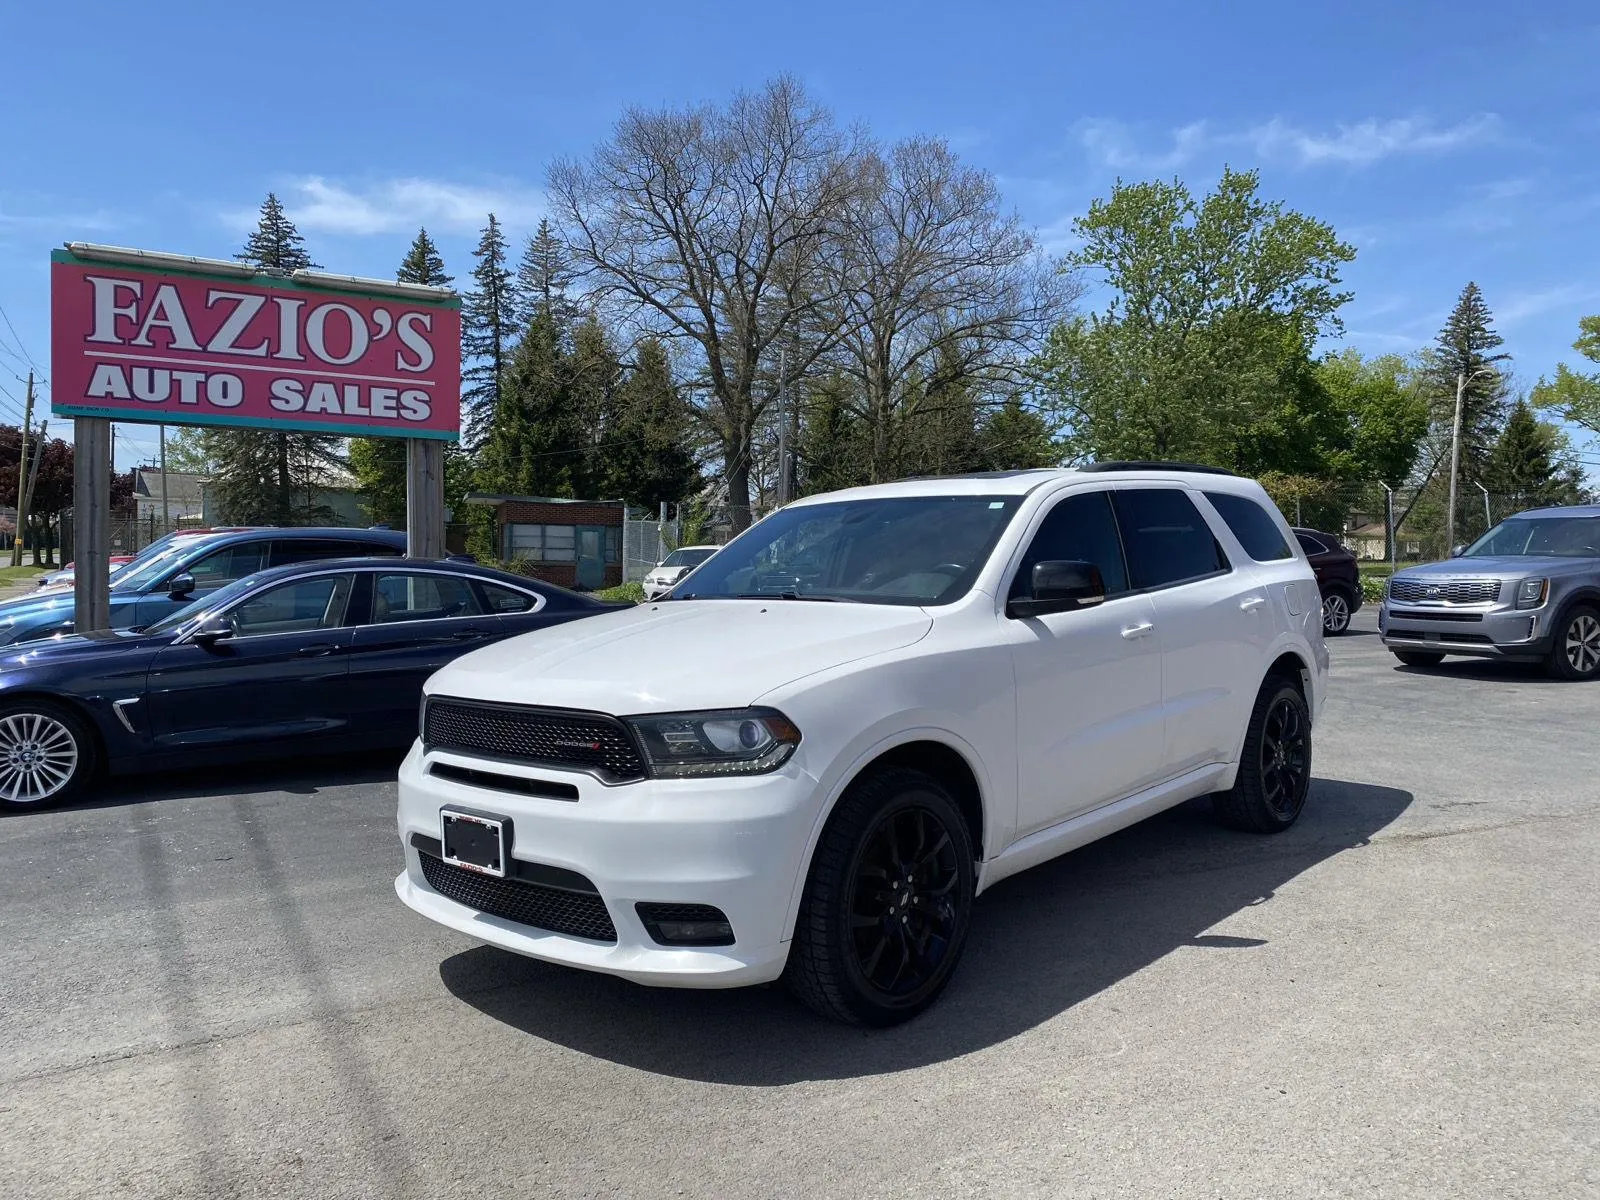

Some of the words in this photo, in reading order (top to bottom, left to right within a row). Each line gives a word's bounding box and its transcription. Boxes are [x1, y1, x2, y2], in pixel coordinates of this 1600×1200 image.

[84, 274, 436, 373] FAZIO'S
[86, 363, 244, 408] AUTO
[269, 378, 432, 421] SALES
[556, 740, 593, 748] DODGE
